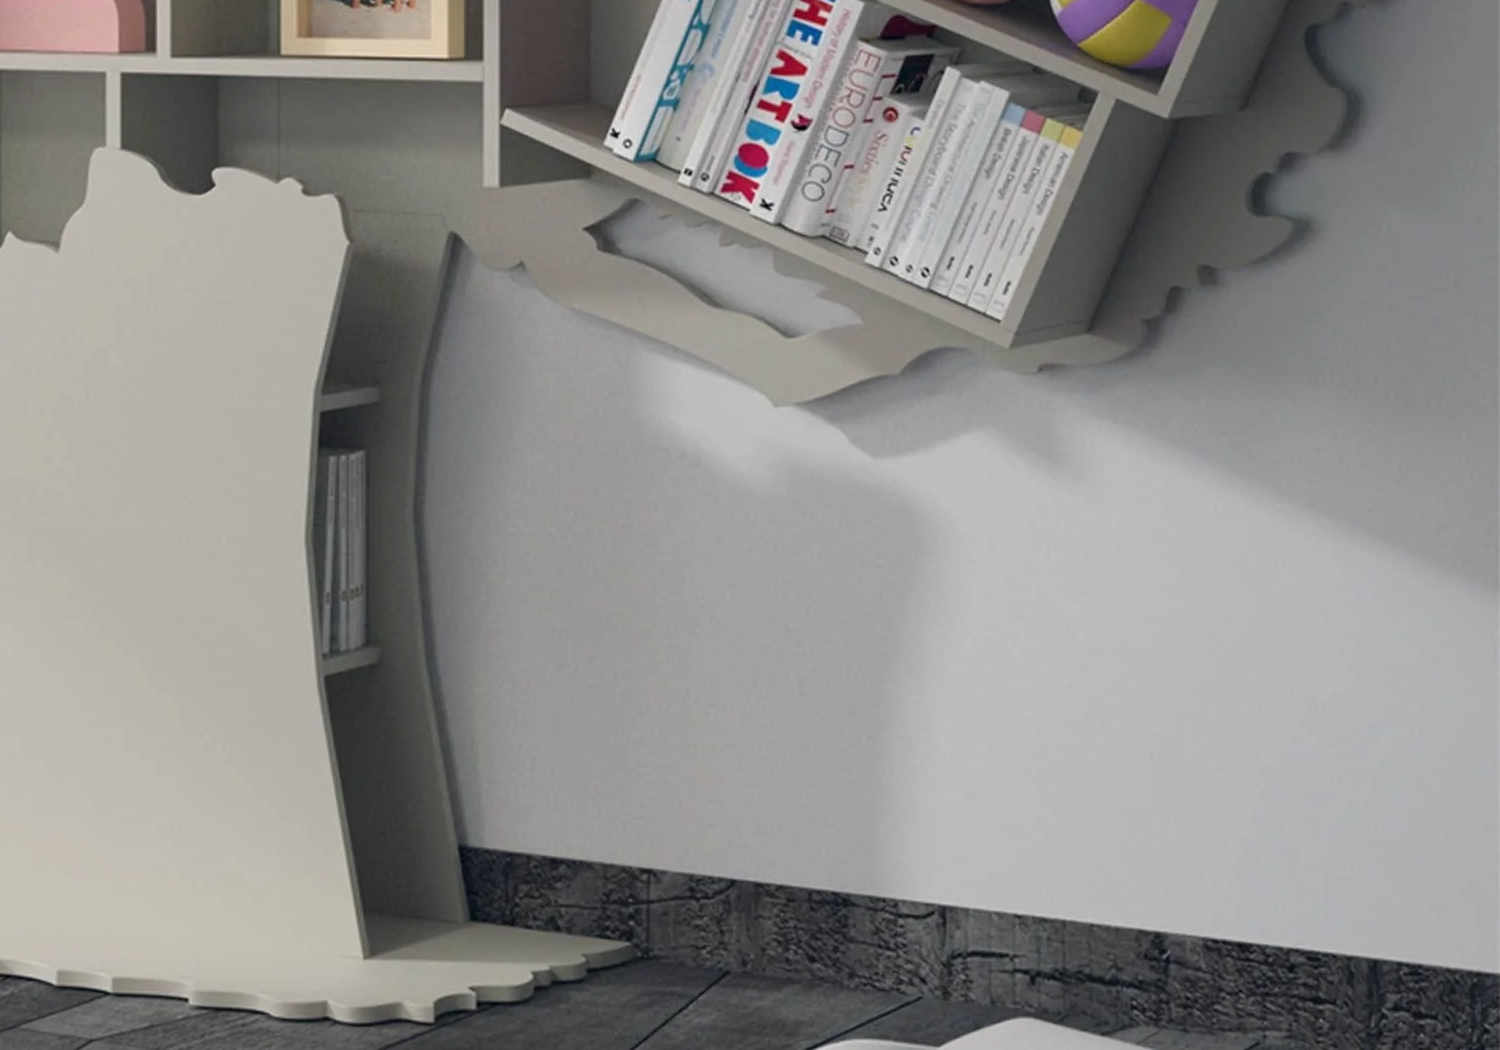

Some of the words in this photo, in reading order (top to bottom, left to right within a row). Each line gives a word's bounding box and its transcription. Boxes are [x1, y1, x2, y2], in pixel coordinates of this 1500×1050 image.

[758, 51, 807, 122] ART
[721, 120, 780, 202] BOOK
[982, 152, 1001, 181] Design
[995, 172, 1014, 200] Design
[1021, 166, 1039, 195] Design
[1034, 187, 1052, 216] Design
